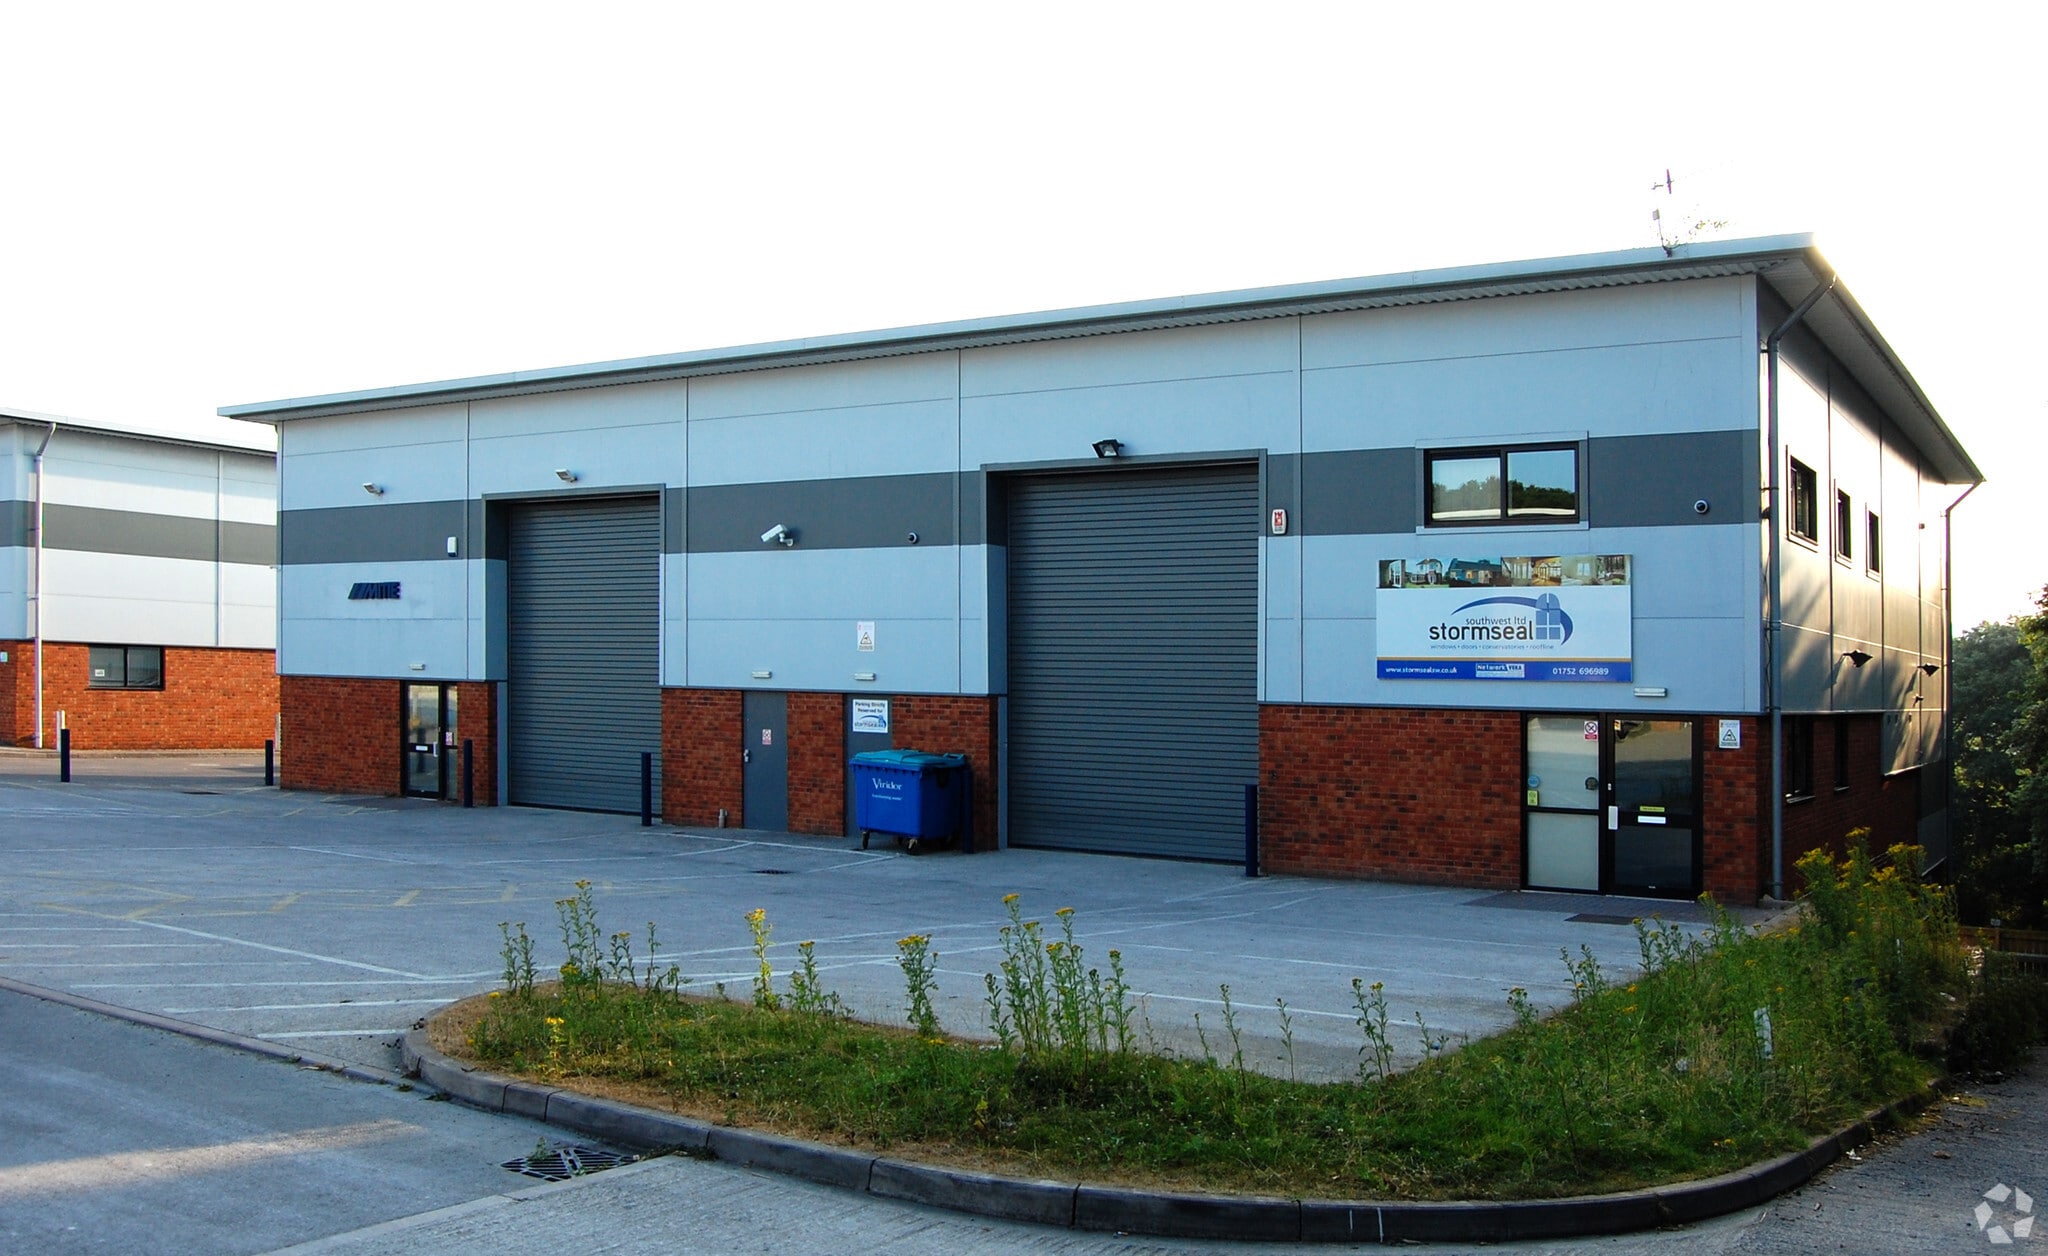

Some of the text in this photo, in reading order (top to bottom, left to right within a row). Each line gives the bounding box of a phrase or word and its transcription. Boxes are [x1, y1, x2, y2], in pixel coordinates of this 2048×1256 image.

[1465, 616, 1527, 625] southwest ltd
[1429, 620, 1534, 640] stormseal
[1552, 667, 1609, 676] 01752 696989
[872, 778, 903, 790] Viridor
